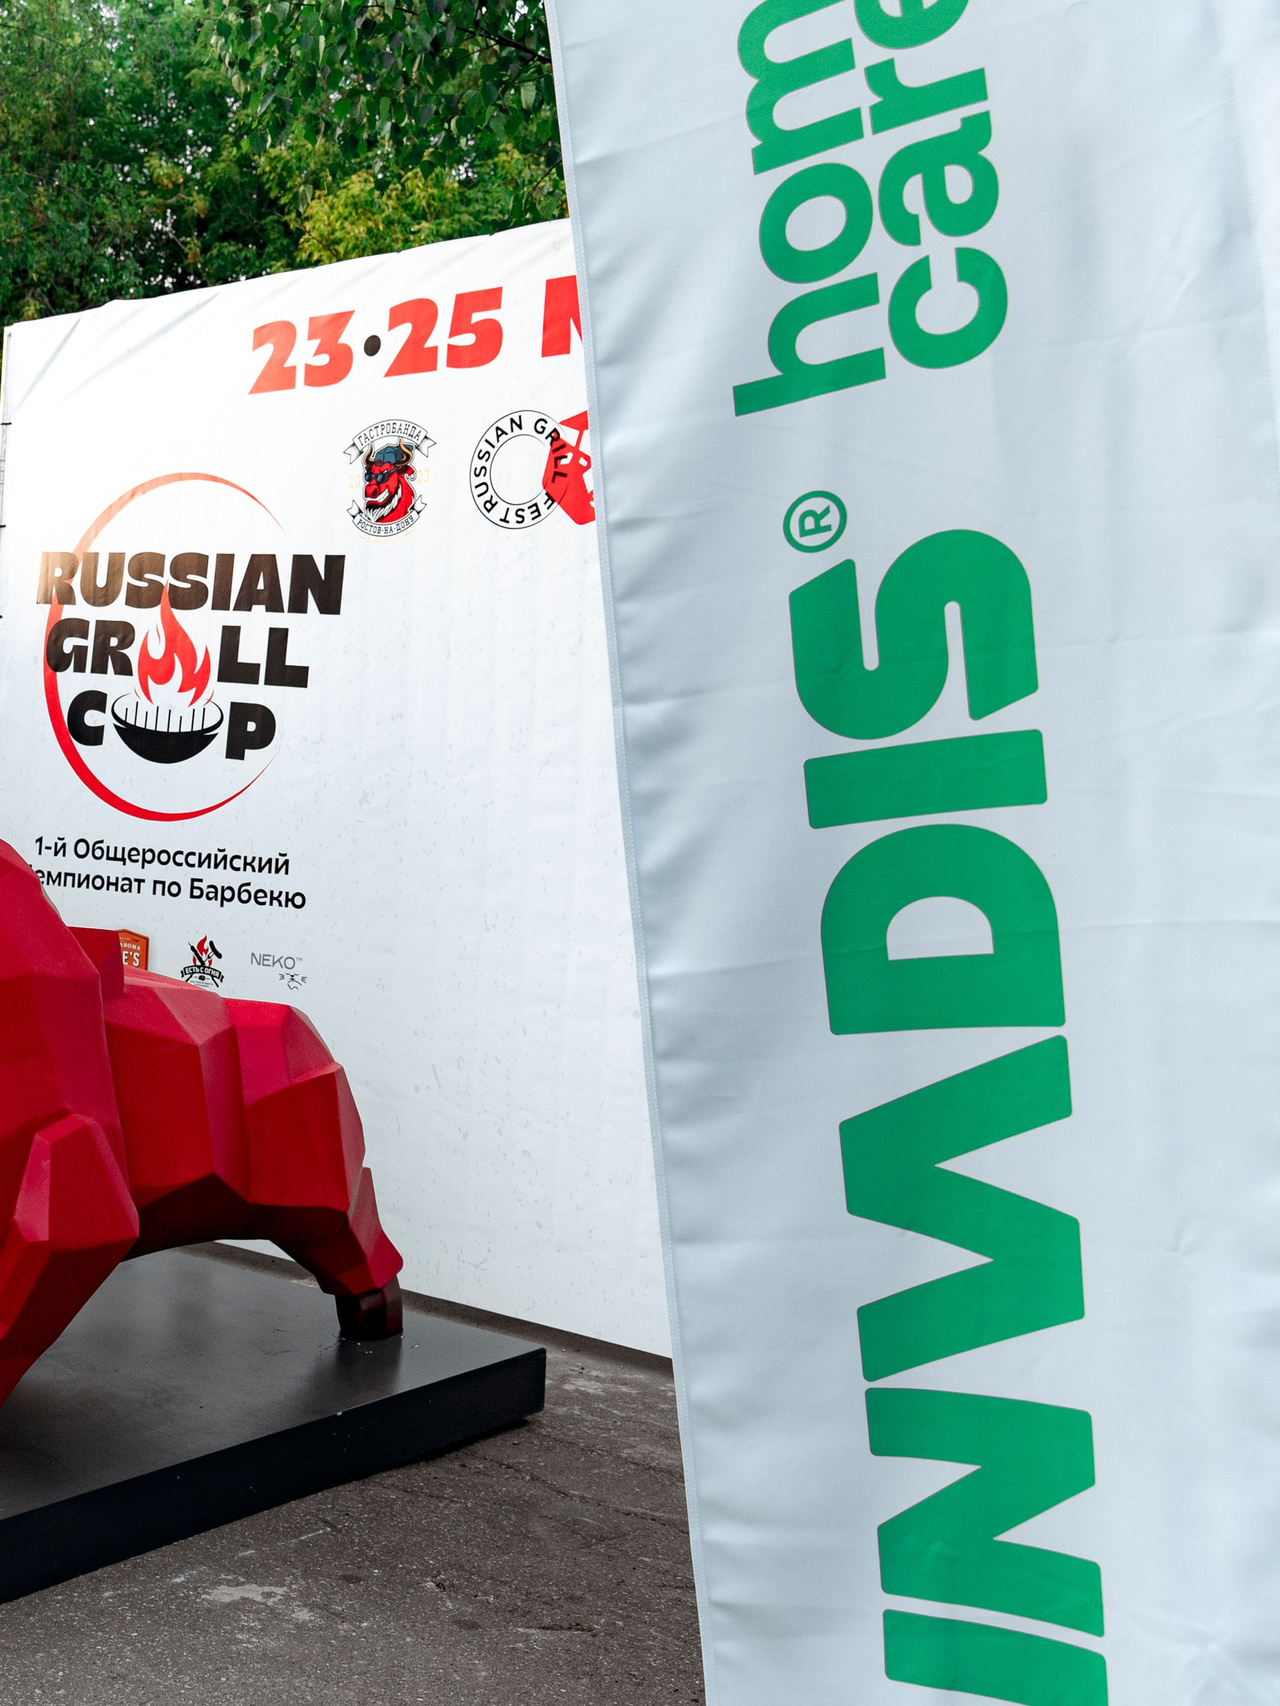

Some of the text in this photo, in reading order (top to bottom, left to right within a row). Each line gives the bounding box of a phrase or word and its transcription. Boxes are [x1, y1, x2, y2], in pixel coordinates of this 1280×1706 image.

[357, 422, 422, 447] ГАСТРОБАНДА
[533, 417, 568, 483] GRILL
[473, 414, 523, 514] RUSSIAN
[498, 491, 556, 525] FEST
[36, 551, 346, 615] RUSSIAN
[34, 836, 291, 876] 1-й Общероссийский
[29, 864, 308, 910] емпионат по Барбекю
[185, 966, 200, 974] ЕСТЬ
[204, 967, 220, 978] ОГНЯ
